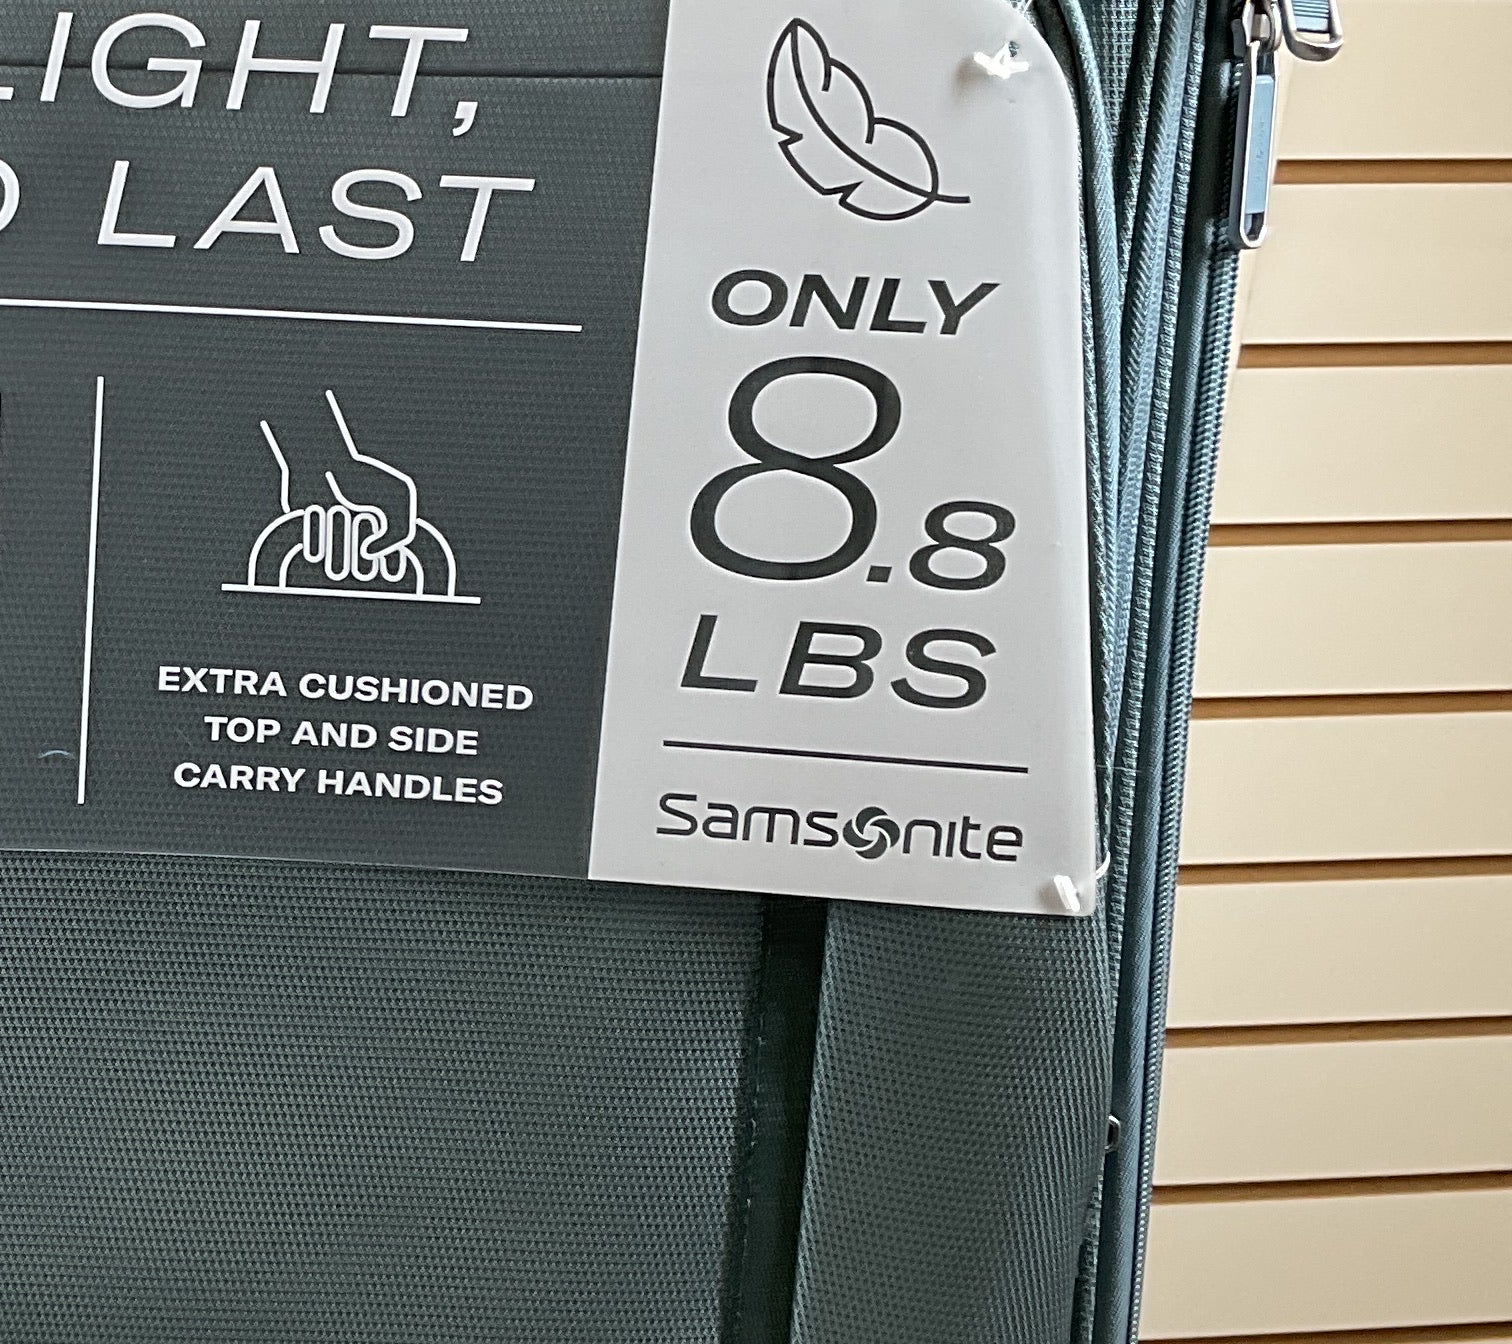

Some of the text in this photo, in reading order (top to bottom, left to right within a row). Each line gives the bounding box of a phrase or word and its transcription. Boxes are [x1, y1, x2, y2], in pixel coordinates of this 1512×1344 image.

[96, 159, 537, 263] LAST
[710, 268, 1002, 337] ONLY
[157, 664, 535, 711] EXTRA CUSHIONED
[679, 613, 998, 710] LBS
[202, 714, 480, 757] TOP AND SIDE
[172, 761, 505, 806] CARRY HANDLES
[655, 791, 1024, 863] Samsonite
